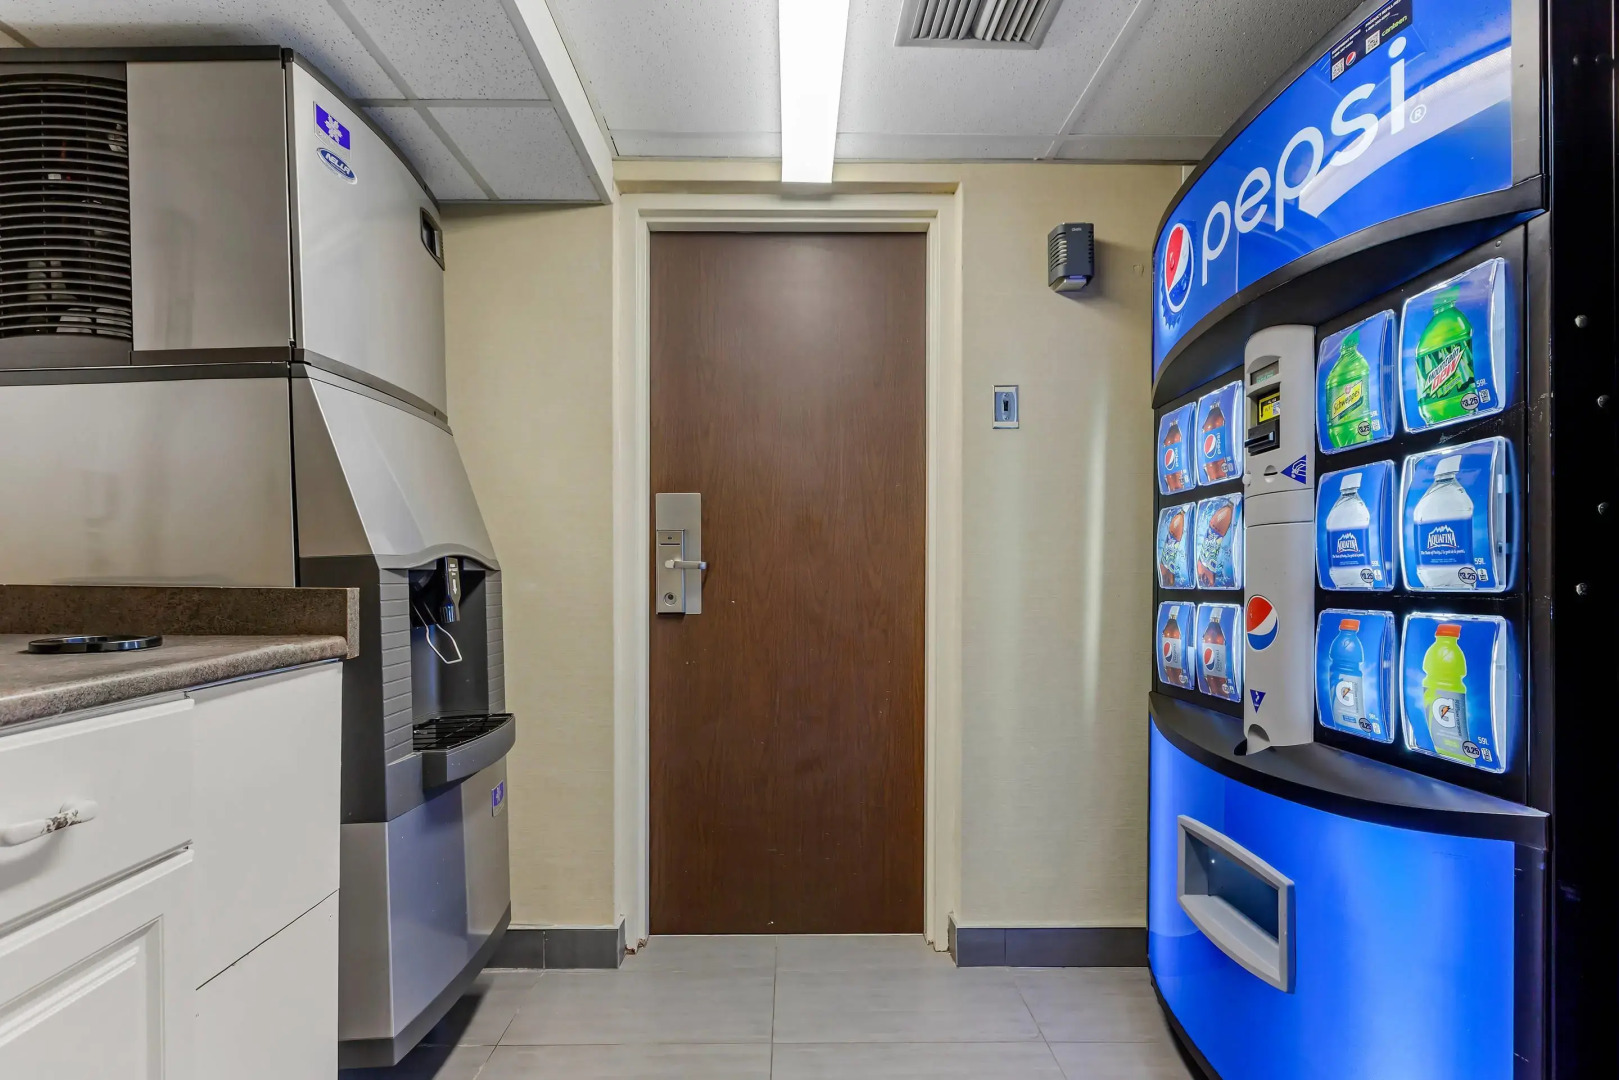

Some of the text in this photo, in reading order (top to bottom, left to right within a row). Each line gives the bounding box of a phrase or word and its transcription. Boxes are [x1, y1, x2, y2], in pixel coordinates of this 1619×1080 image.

[1381, 15, 1408, 37] canteen
[1202, 36, 1407, 287] pepsi
[1432, 697, 1456, 728] G
